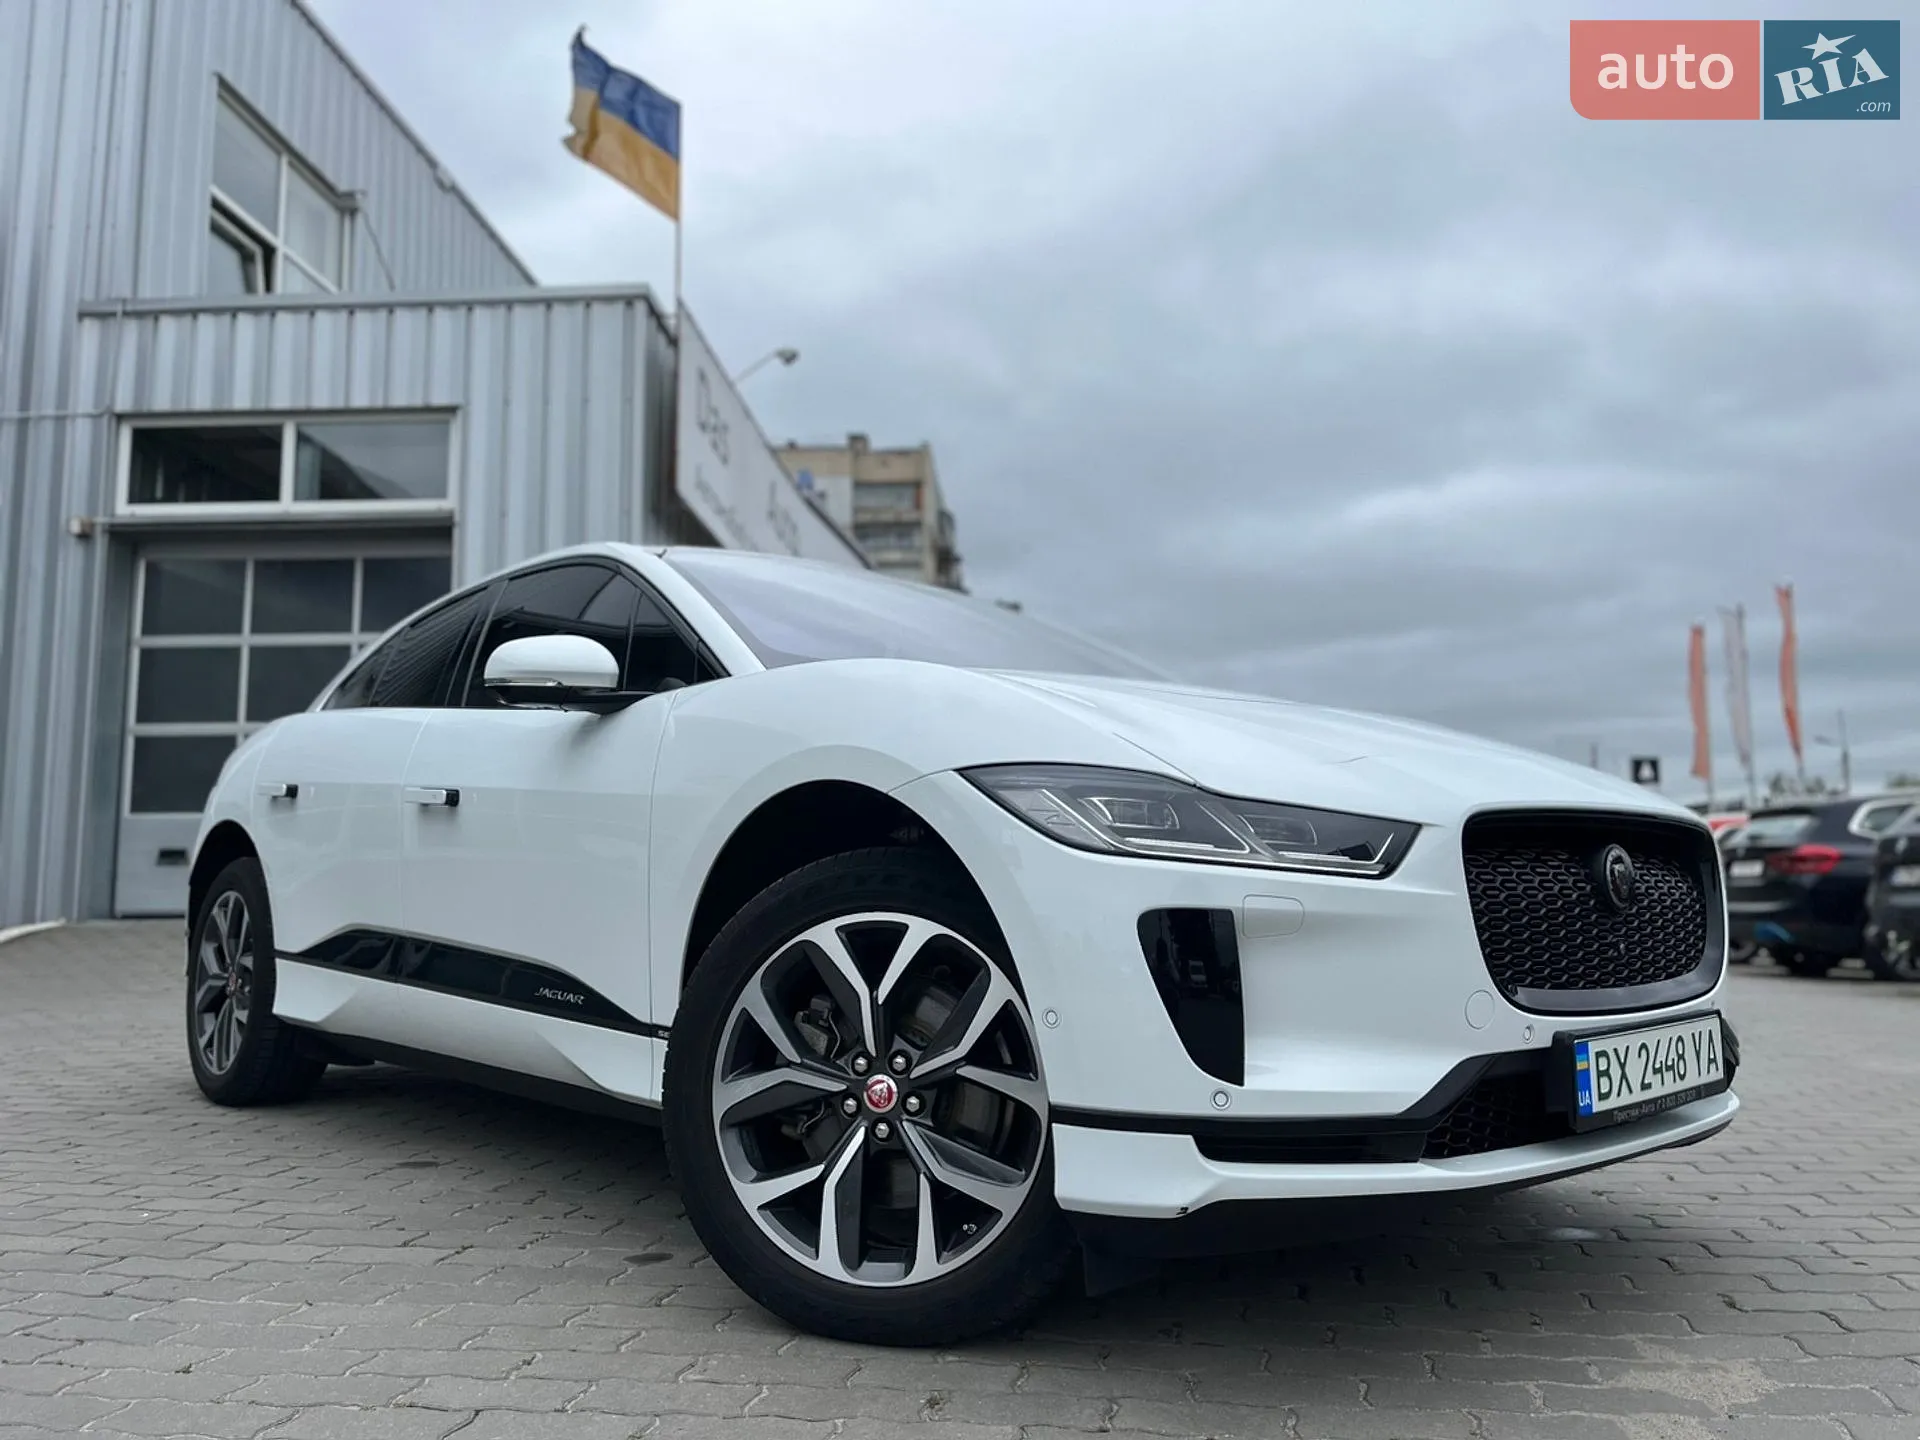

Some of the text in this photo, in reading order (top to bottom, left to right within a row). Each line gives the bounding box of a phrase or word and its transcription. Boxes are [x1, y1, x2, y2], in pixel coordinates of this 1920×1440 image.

[534, 986, 584, 1005] JAGUAR
[1595, 1045, 1633, 1102] BX
[1638, 1035, 1687, 1092] 2448
[1691, 1028, 1719, 1077] YA
[1578, 1090, 1593, 1107] UA
